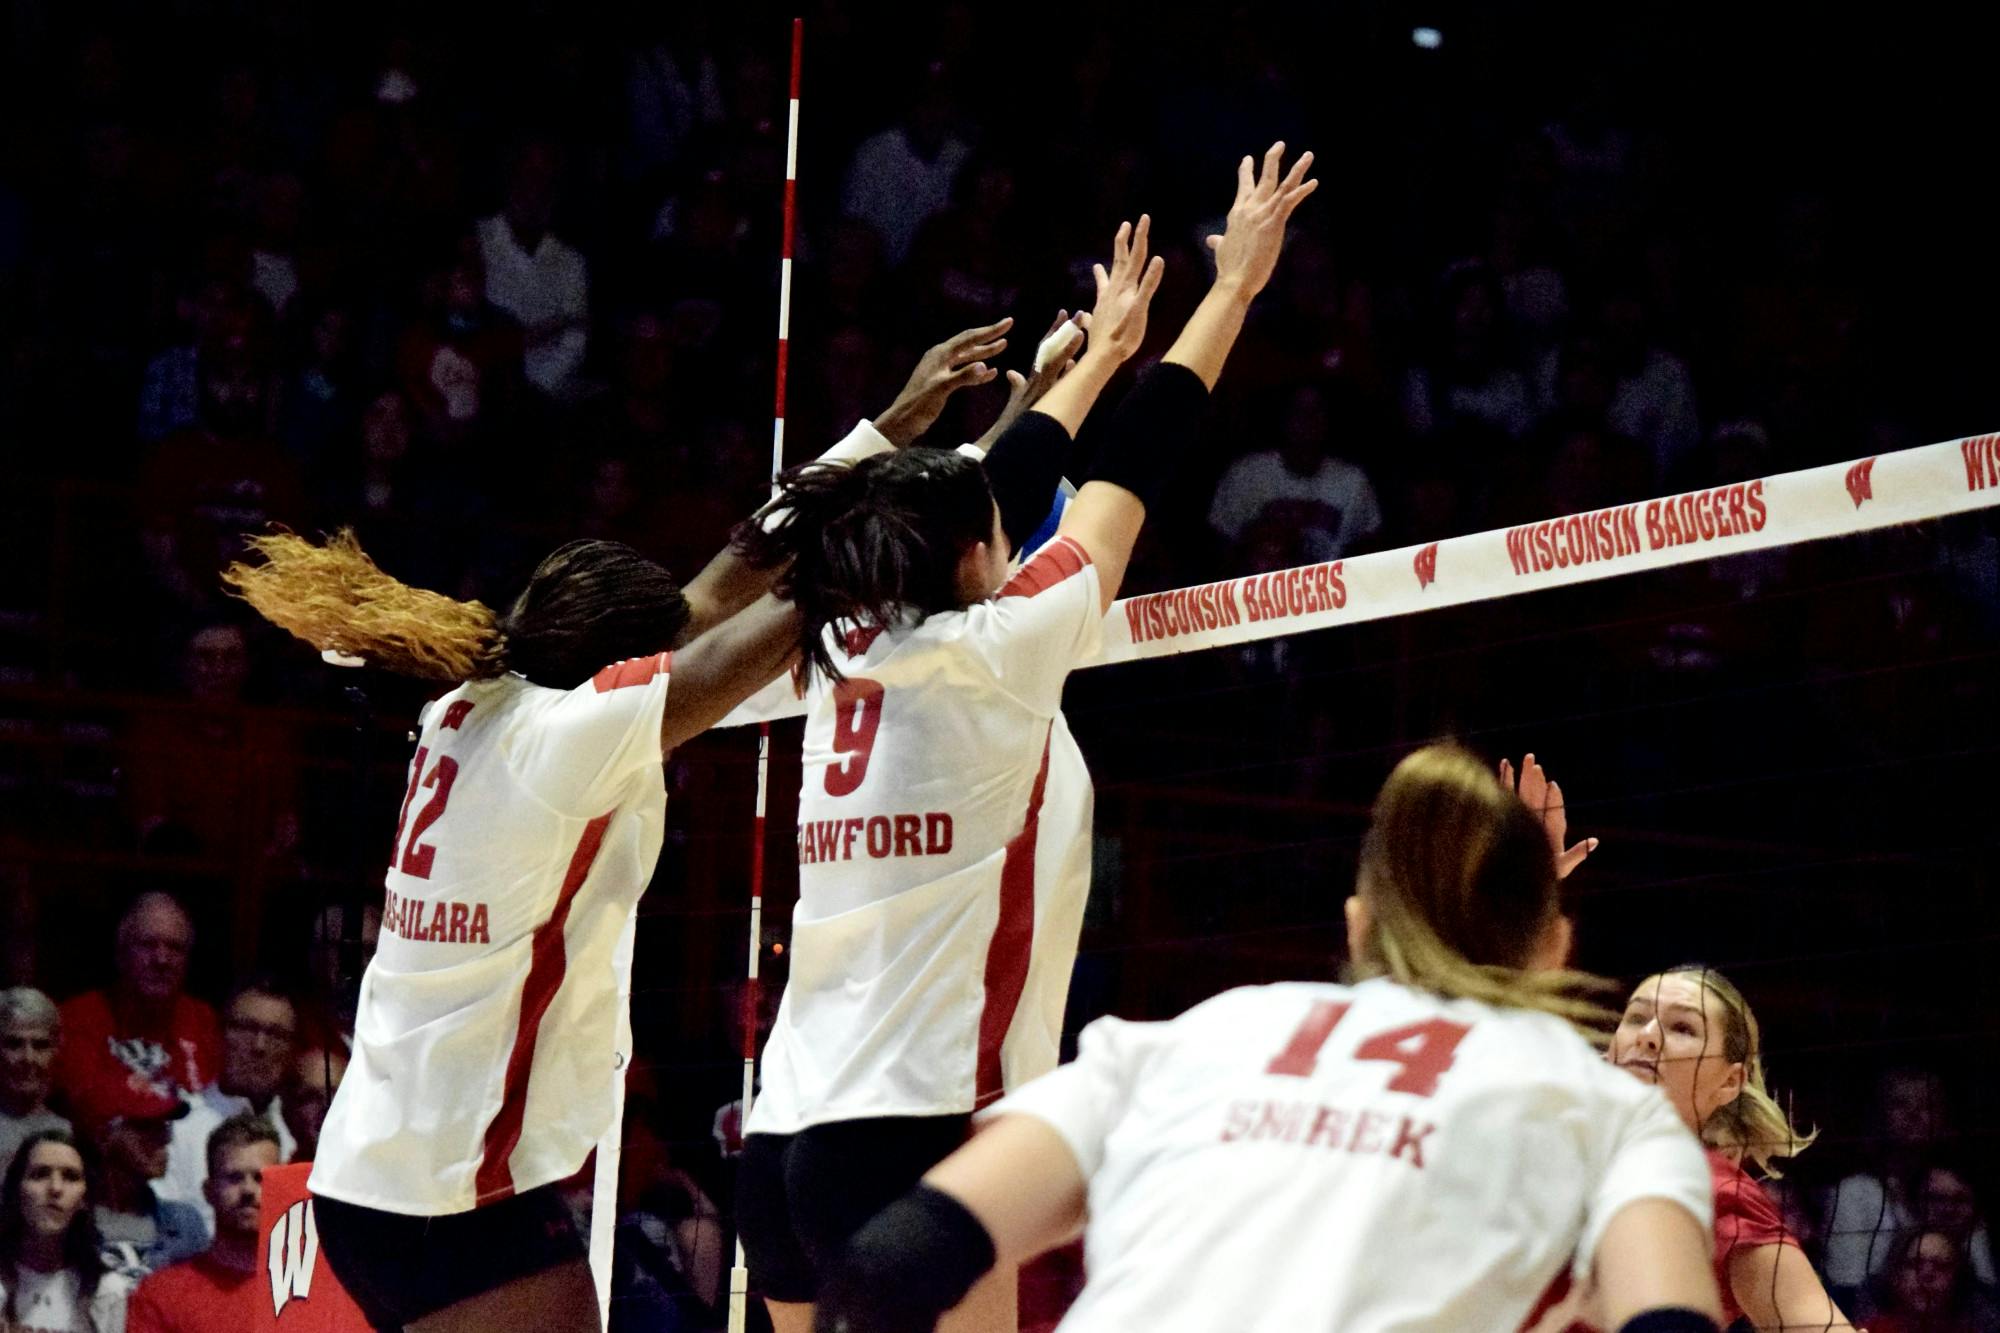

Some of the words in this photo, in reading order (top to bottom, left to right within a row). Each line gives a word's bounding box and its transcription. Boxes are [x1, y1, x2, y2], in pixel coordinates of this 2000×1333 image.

[1506, 504, 1641, 575] WISCONSIN
[1646, 480, 1767, 550] BADGERS
[1125, 580, 1241, 643] WISCONSIN
[1242, 561, 1347, 622] BADGERS
[824, 677, 885, 797] 9
[799, 812, 953, 864] AWFORD
[1264, 1000, 1475, 1098] 14
[1219, 1101, 1436, 1169] SMREK
